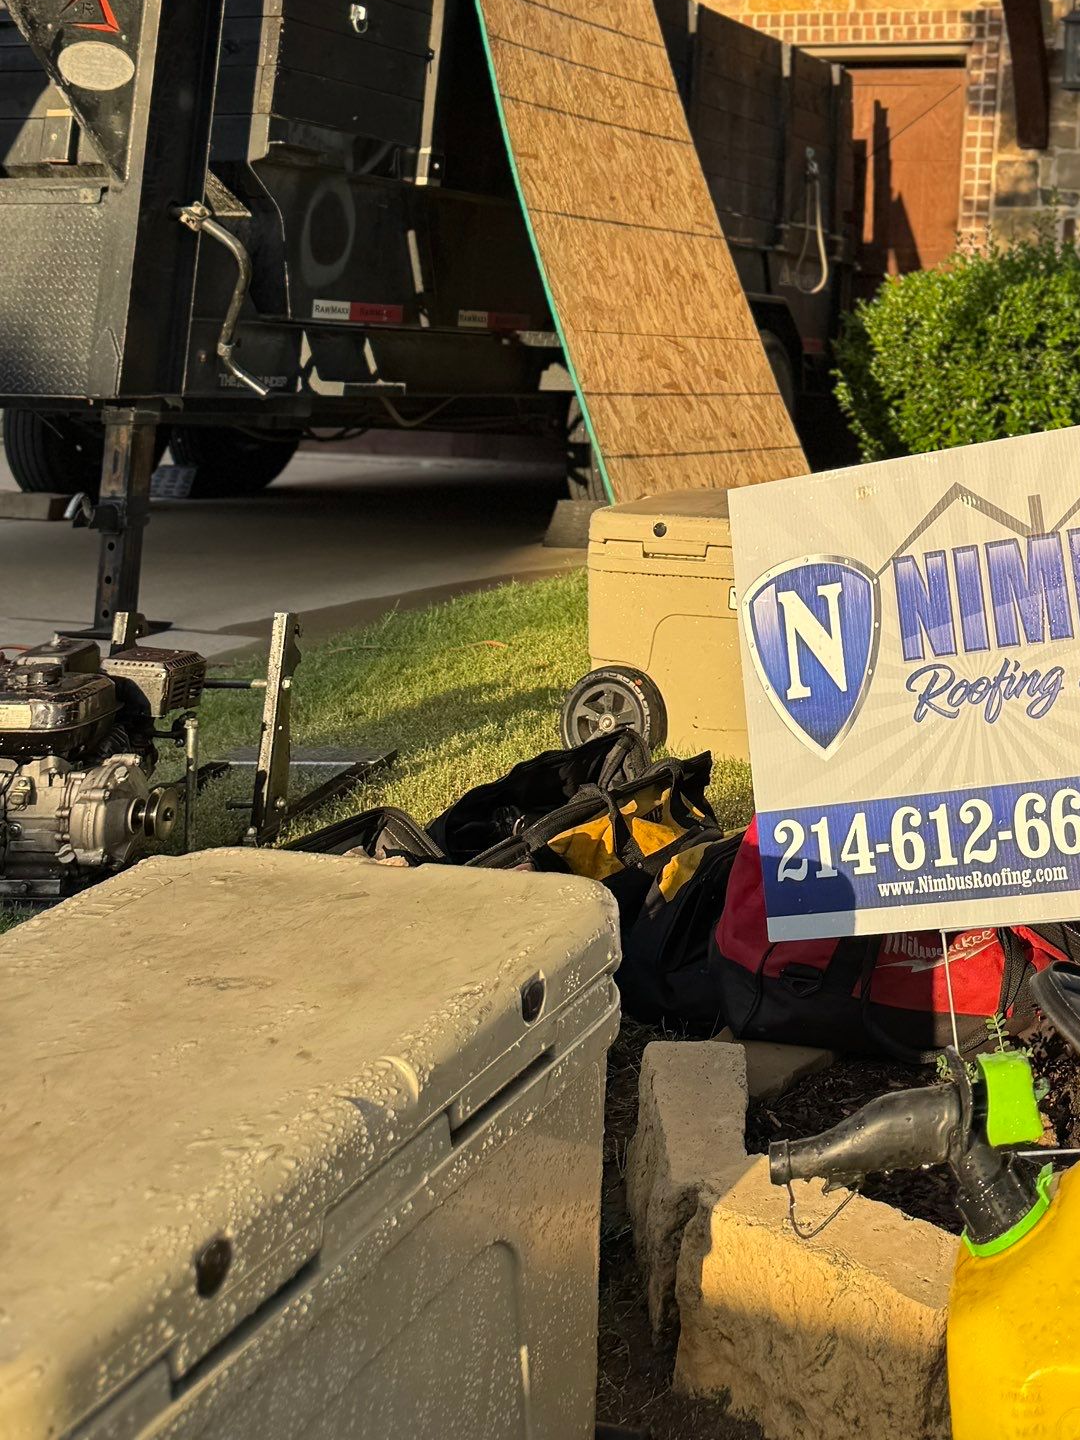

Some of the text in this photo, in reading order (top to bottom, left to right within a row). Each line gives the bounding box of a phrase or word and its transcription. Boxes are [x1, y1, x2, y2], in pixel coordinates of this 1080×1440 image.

[777, 582, 848, 701] N
[905, 656, 1065, 724] Roofing
[877, 863, 1069, 898] www.NimbusRoofing.com
